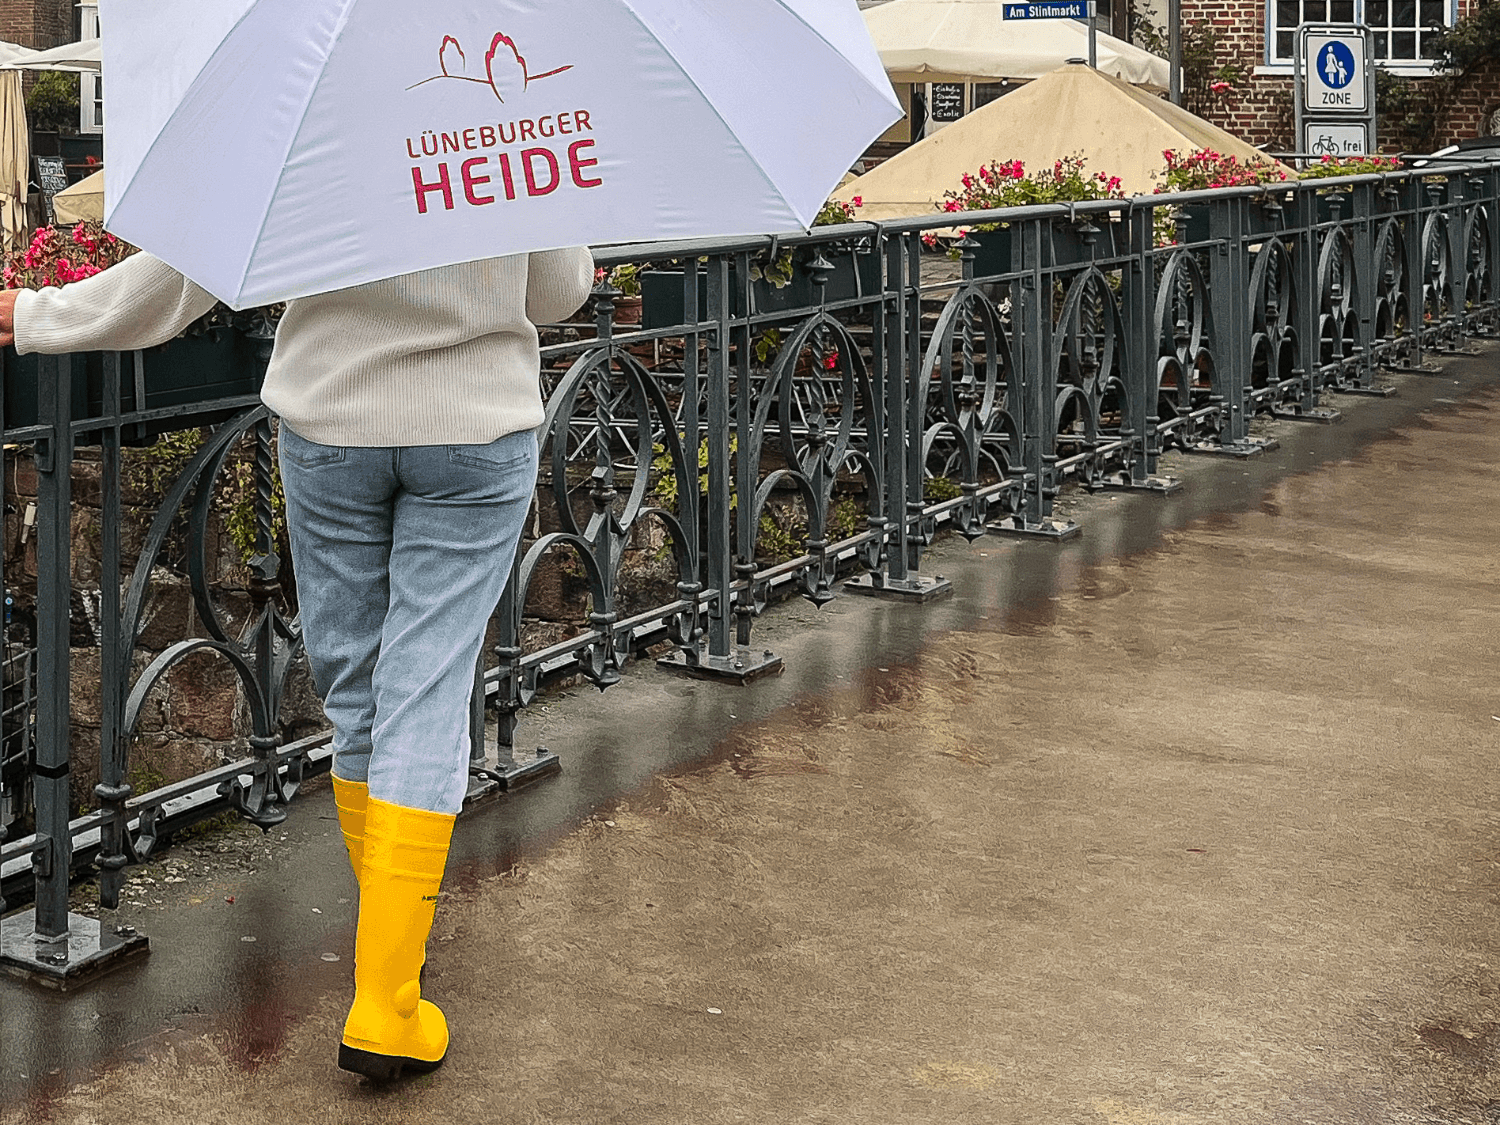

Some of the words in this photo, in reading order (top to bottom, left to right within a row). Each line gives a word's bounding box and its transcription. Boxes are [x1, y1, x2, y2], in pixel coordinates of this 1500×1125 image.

[1009, 6, 1025, 18] Am
[1028, 3, 1081, 17] Stintmarkt
[1322, 92, 1352, 105] ZONE
[405, 109, 594, 159] LÜNEBURGER
[1343, 139, 1362, 152] frei
[410, 138, 603, 214] HEIDE
